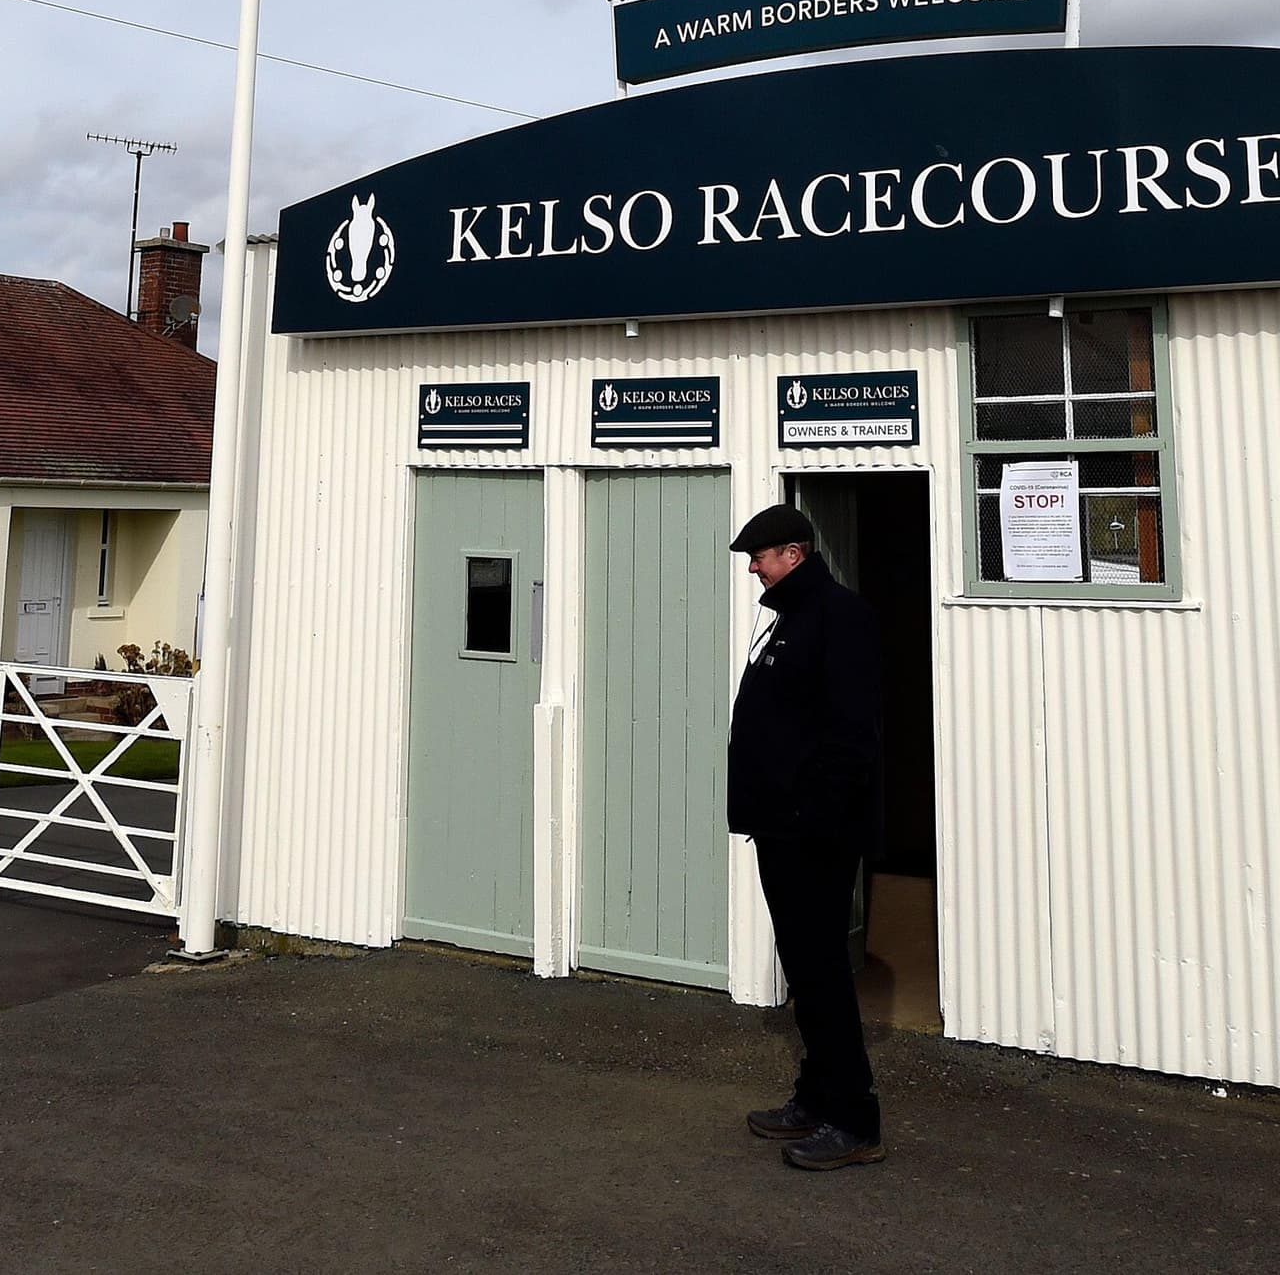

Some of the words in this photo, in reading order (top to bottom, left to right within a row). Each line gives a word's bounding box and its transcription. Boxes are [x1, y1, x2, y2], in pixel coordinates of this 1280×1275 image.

[654, 28, 672, 49] A
[676, 9, 753, 43] WARM
[446, 190, 673, 263] KELSO
[622, 391, 665, 404] KELSO
[668, 390, 711, 403] RACES
[812, 387, 859, 401] KELSO
[863, 385, 910, 399] RACES
[445, 395, 482, 407] KELSO
[485, 394, 522, 406] RACES
[788, 426, 837, 437] OWNERS
[840, 426, 849, 436] &
[852, 424, 908, 436] TRAINERS
[1014, 494, 1065, 508] STOP!
